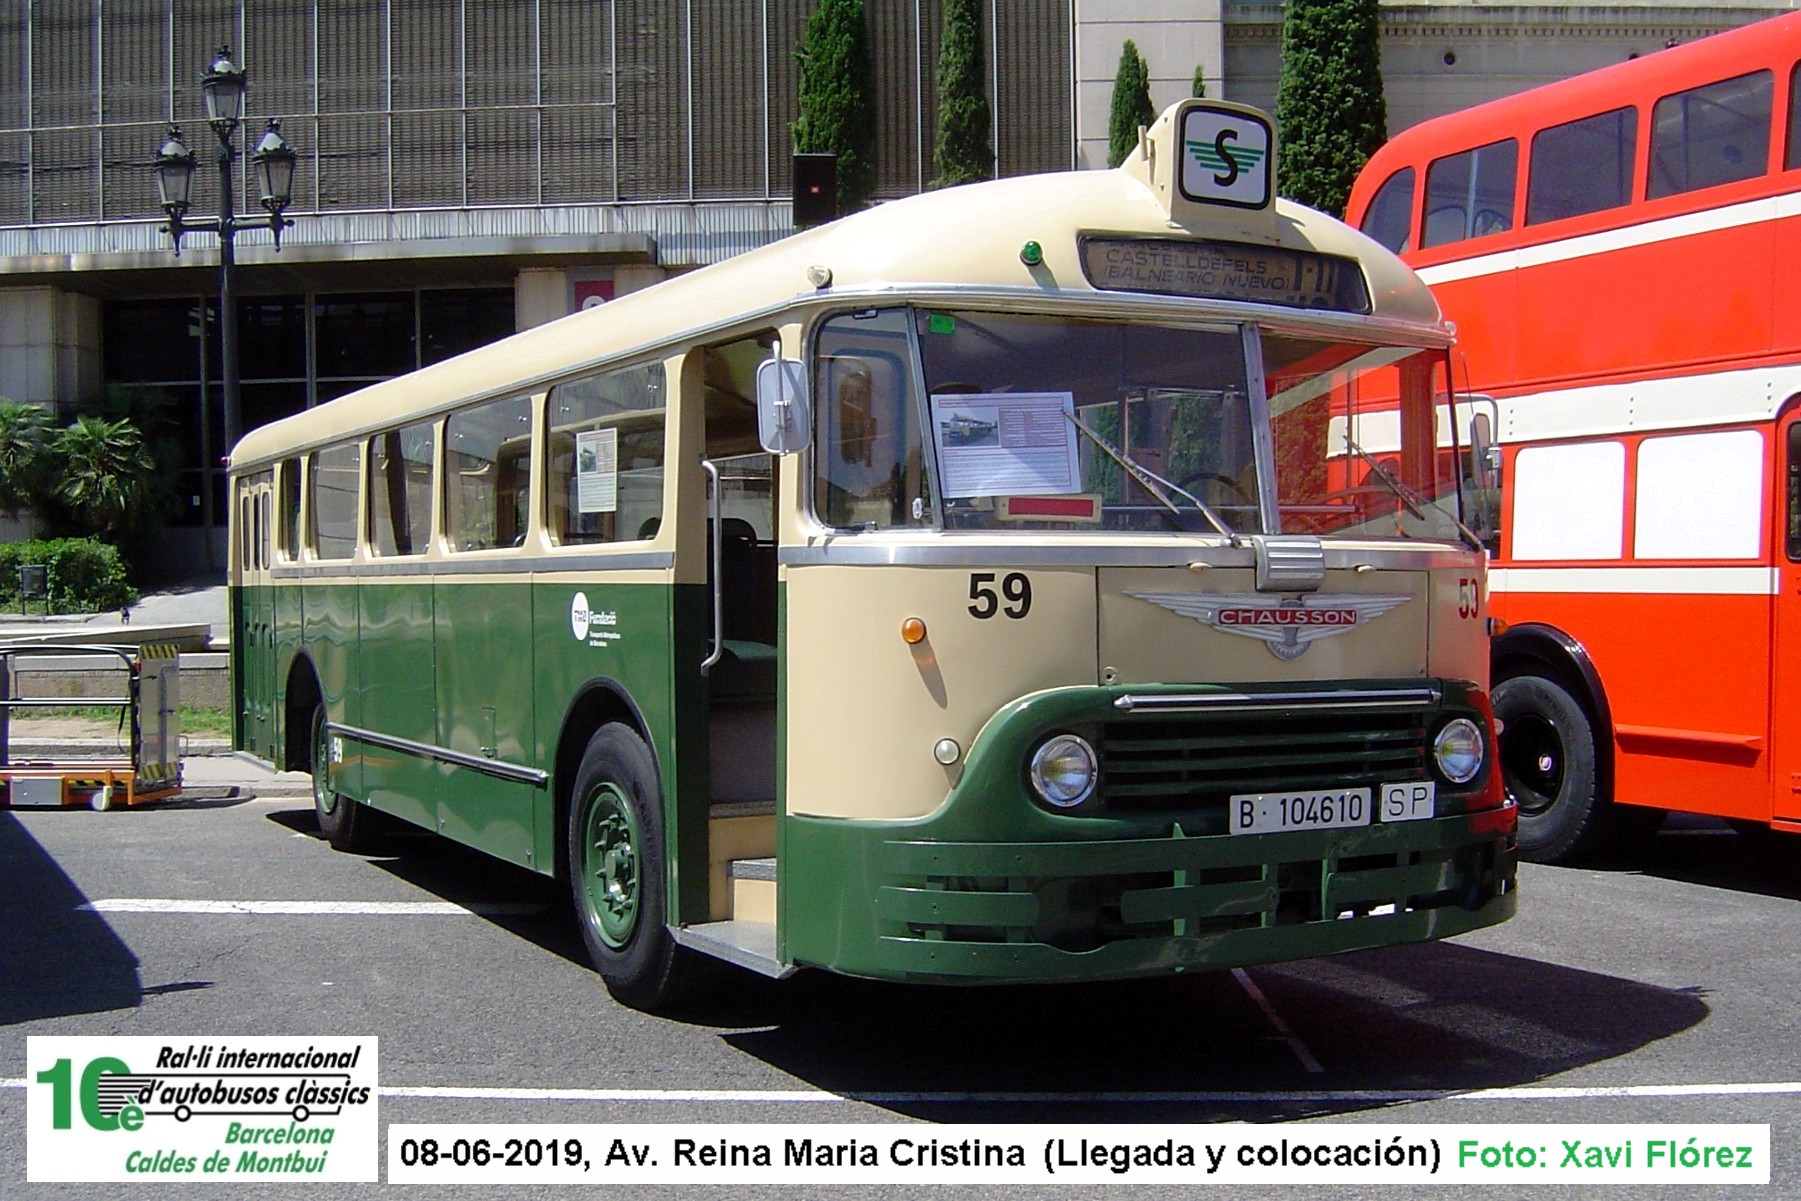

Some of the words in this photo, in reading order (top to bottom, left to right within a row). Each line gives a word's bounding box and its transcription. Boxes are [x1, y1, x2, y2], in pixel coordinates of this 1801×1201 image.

[1214, 129, 1238, 187] S
[1105, 247, 1266, 275] CASTELLDEFELS
[967, 572, 1032, 620] 59
[1220, 610, 1356, 624] CHAUSSON
[1458, 578, 1479, 620] 59
